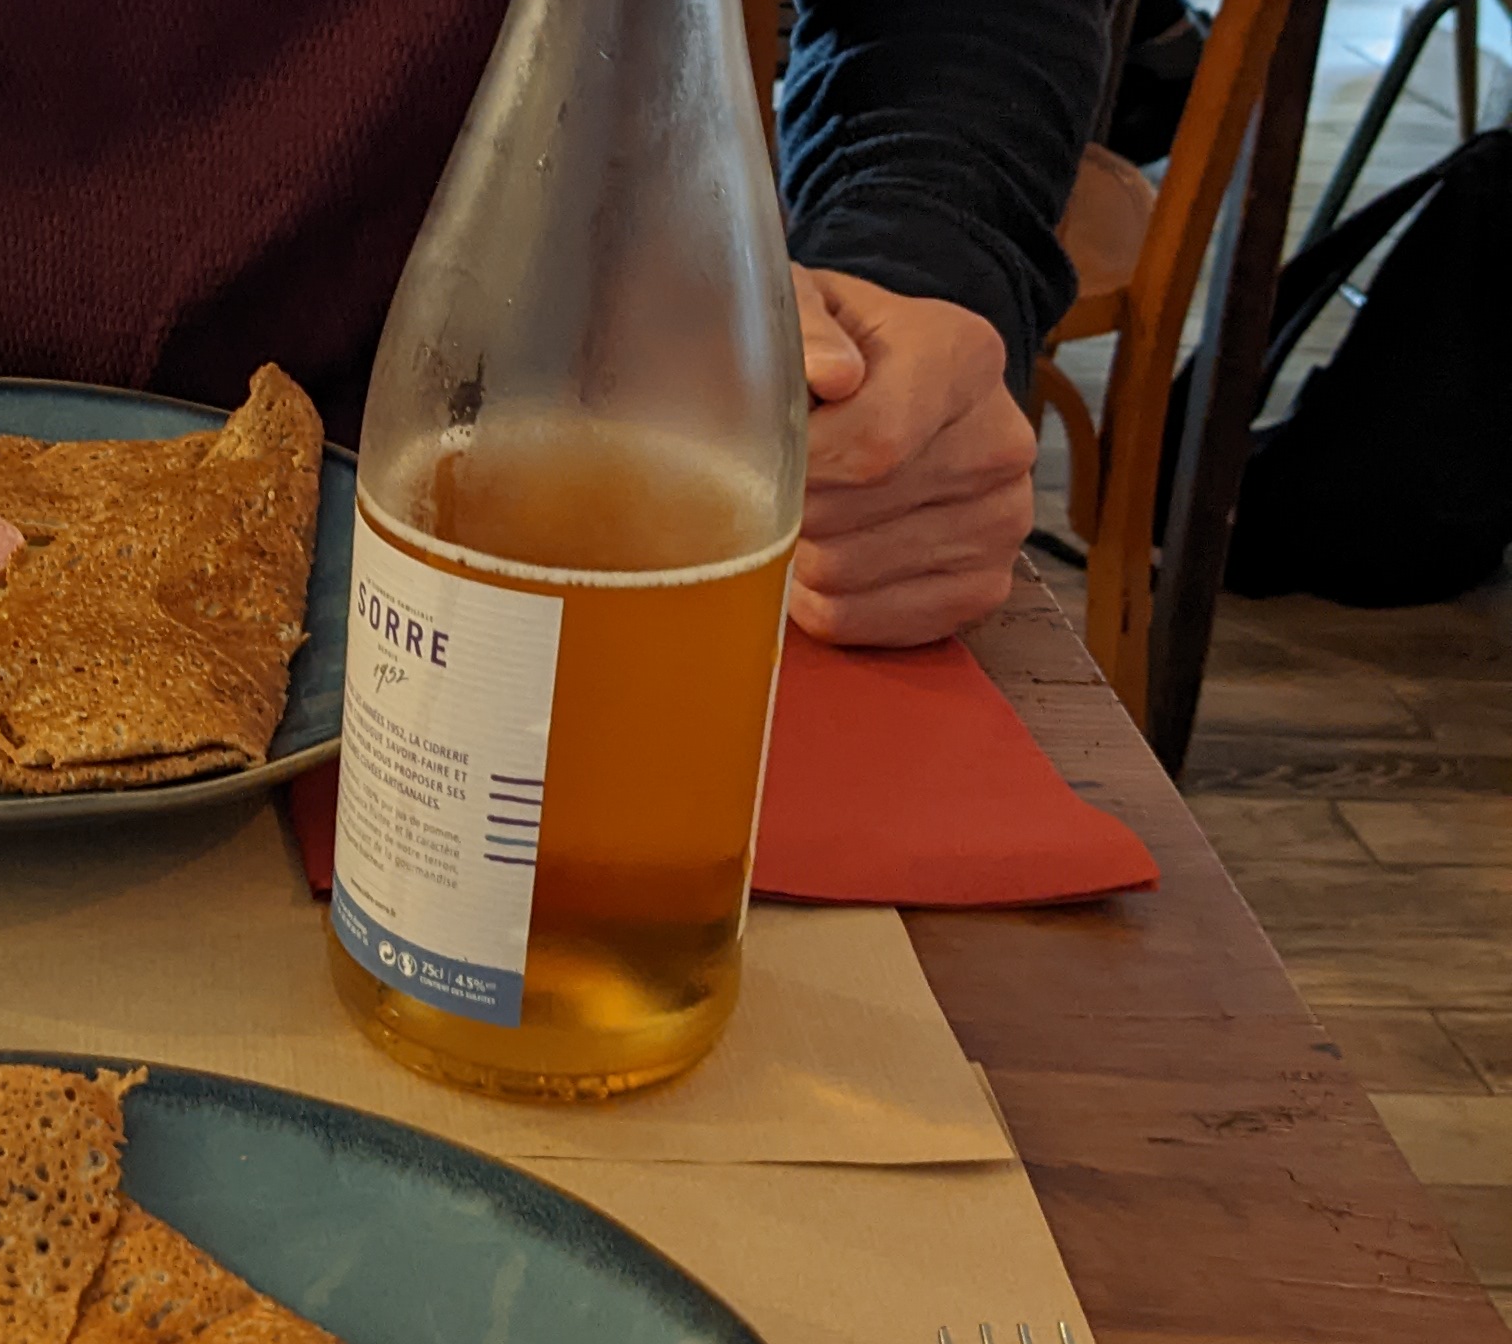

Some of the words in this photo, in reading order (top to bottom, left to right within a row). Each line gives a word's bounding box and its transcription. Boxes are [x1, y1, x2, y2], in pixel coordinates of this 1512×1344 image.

[357, 580, 450, 669] SORRE
[373, 662, 410, 694] 1952
[386, 738, 450, 778] SAVOIR-FAIRE
[454, 768, 468, 783] ET
[409, 733, 420, 748] LA
[423, 740, 470, 766] CIDRERIE
[372, 746, 393, 768] VOUS
[394, 761, 443, 794] PROPOSER
[446, 786, 466, 801] SES
